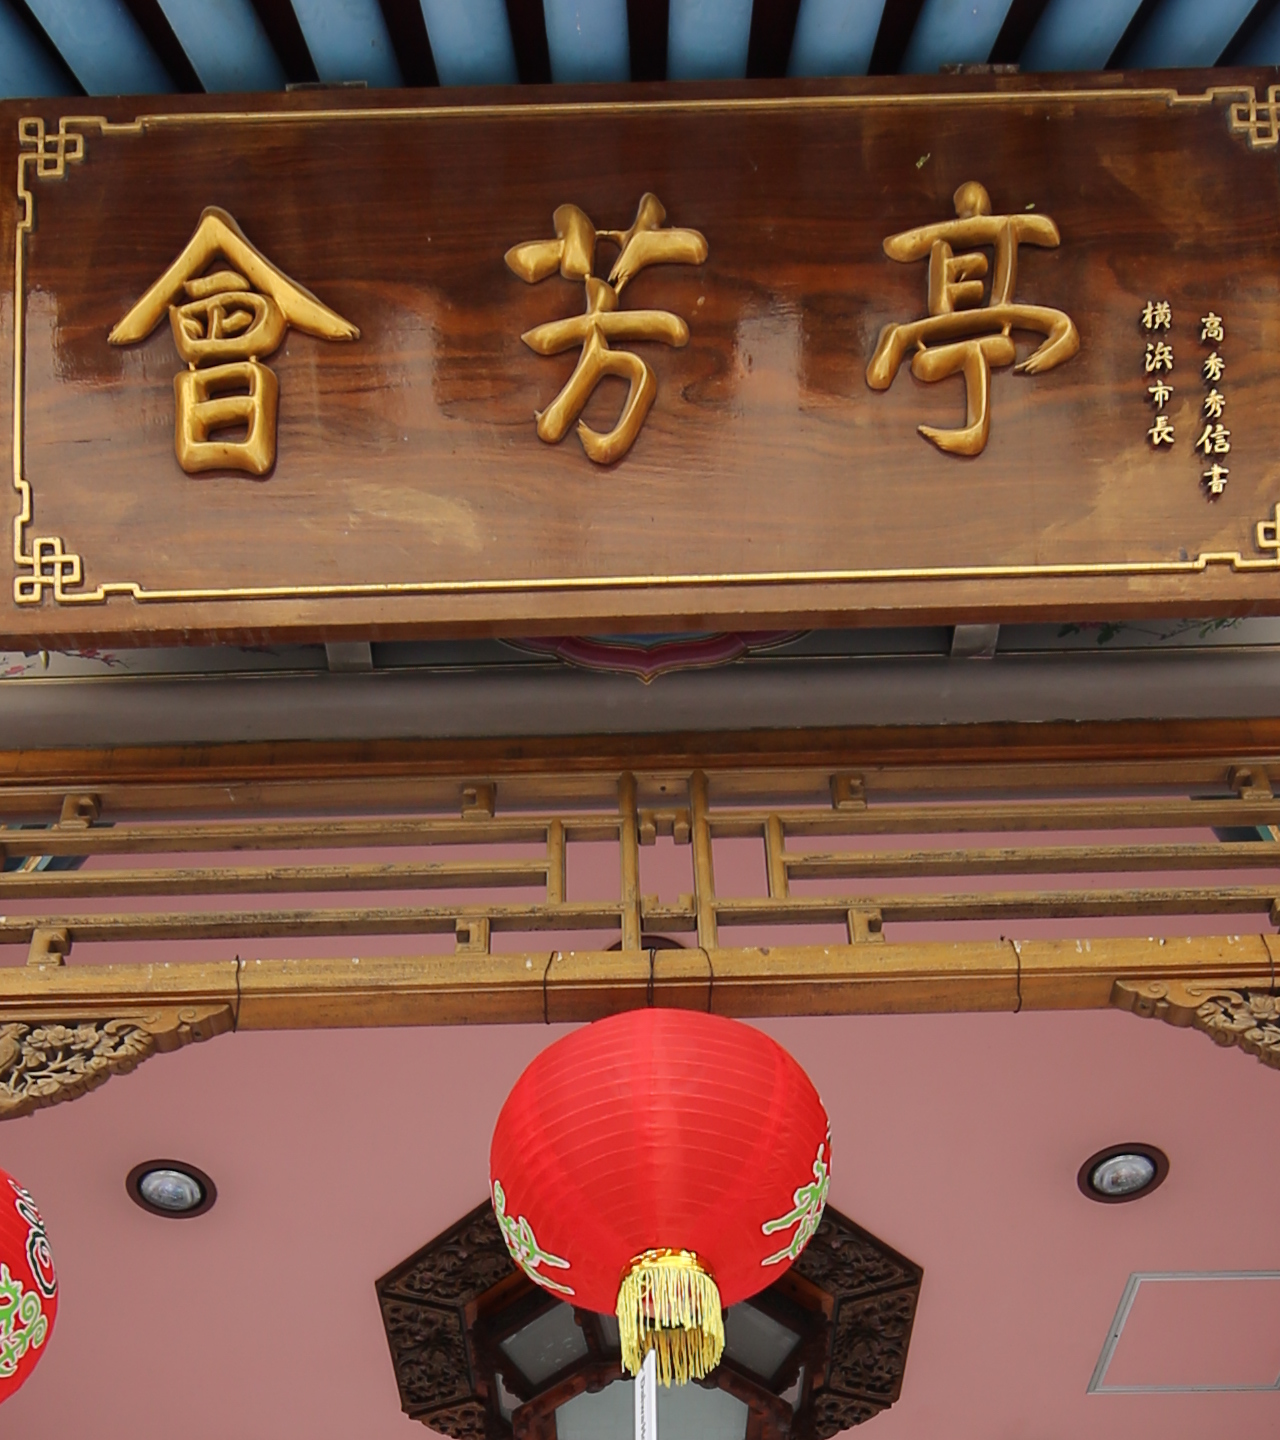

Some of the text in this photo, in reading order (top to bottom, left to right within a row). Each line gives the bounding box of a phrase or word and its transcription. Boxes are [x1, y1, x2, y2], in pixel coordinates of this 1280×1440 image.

[106, 180, 1081, 479] 會芳亭
[1196, 311, 1232, 495] 高秀秀信書
